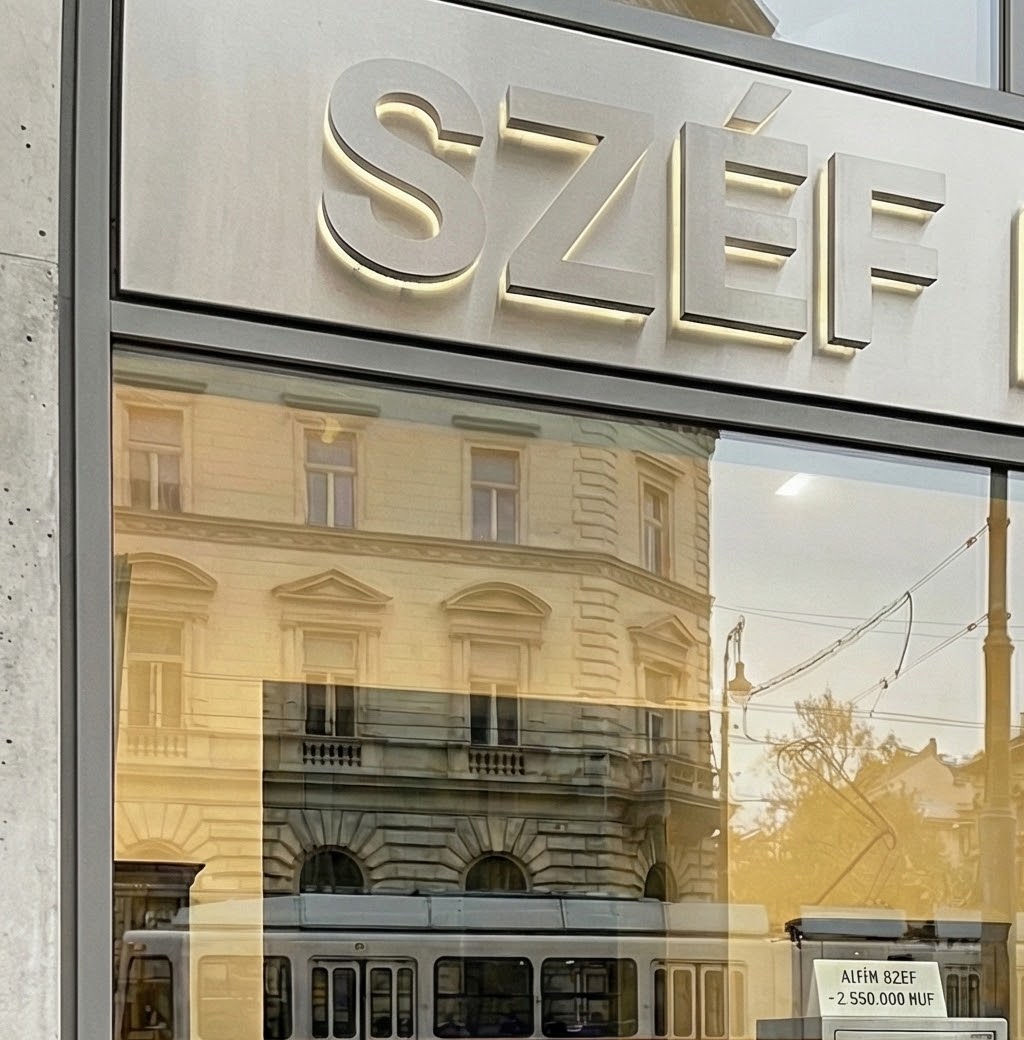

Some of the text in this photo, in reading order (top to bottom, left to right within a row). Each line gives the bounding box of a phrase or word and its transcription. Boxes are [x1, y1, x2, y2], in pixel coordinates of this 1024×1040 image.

[321, 58, 946, 352] SZÉF
[883, 970, 917, 985] 82EF
[908, 992, 934, 1006] HUF
